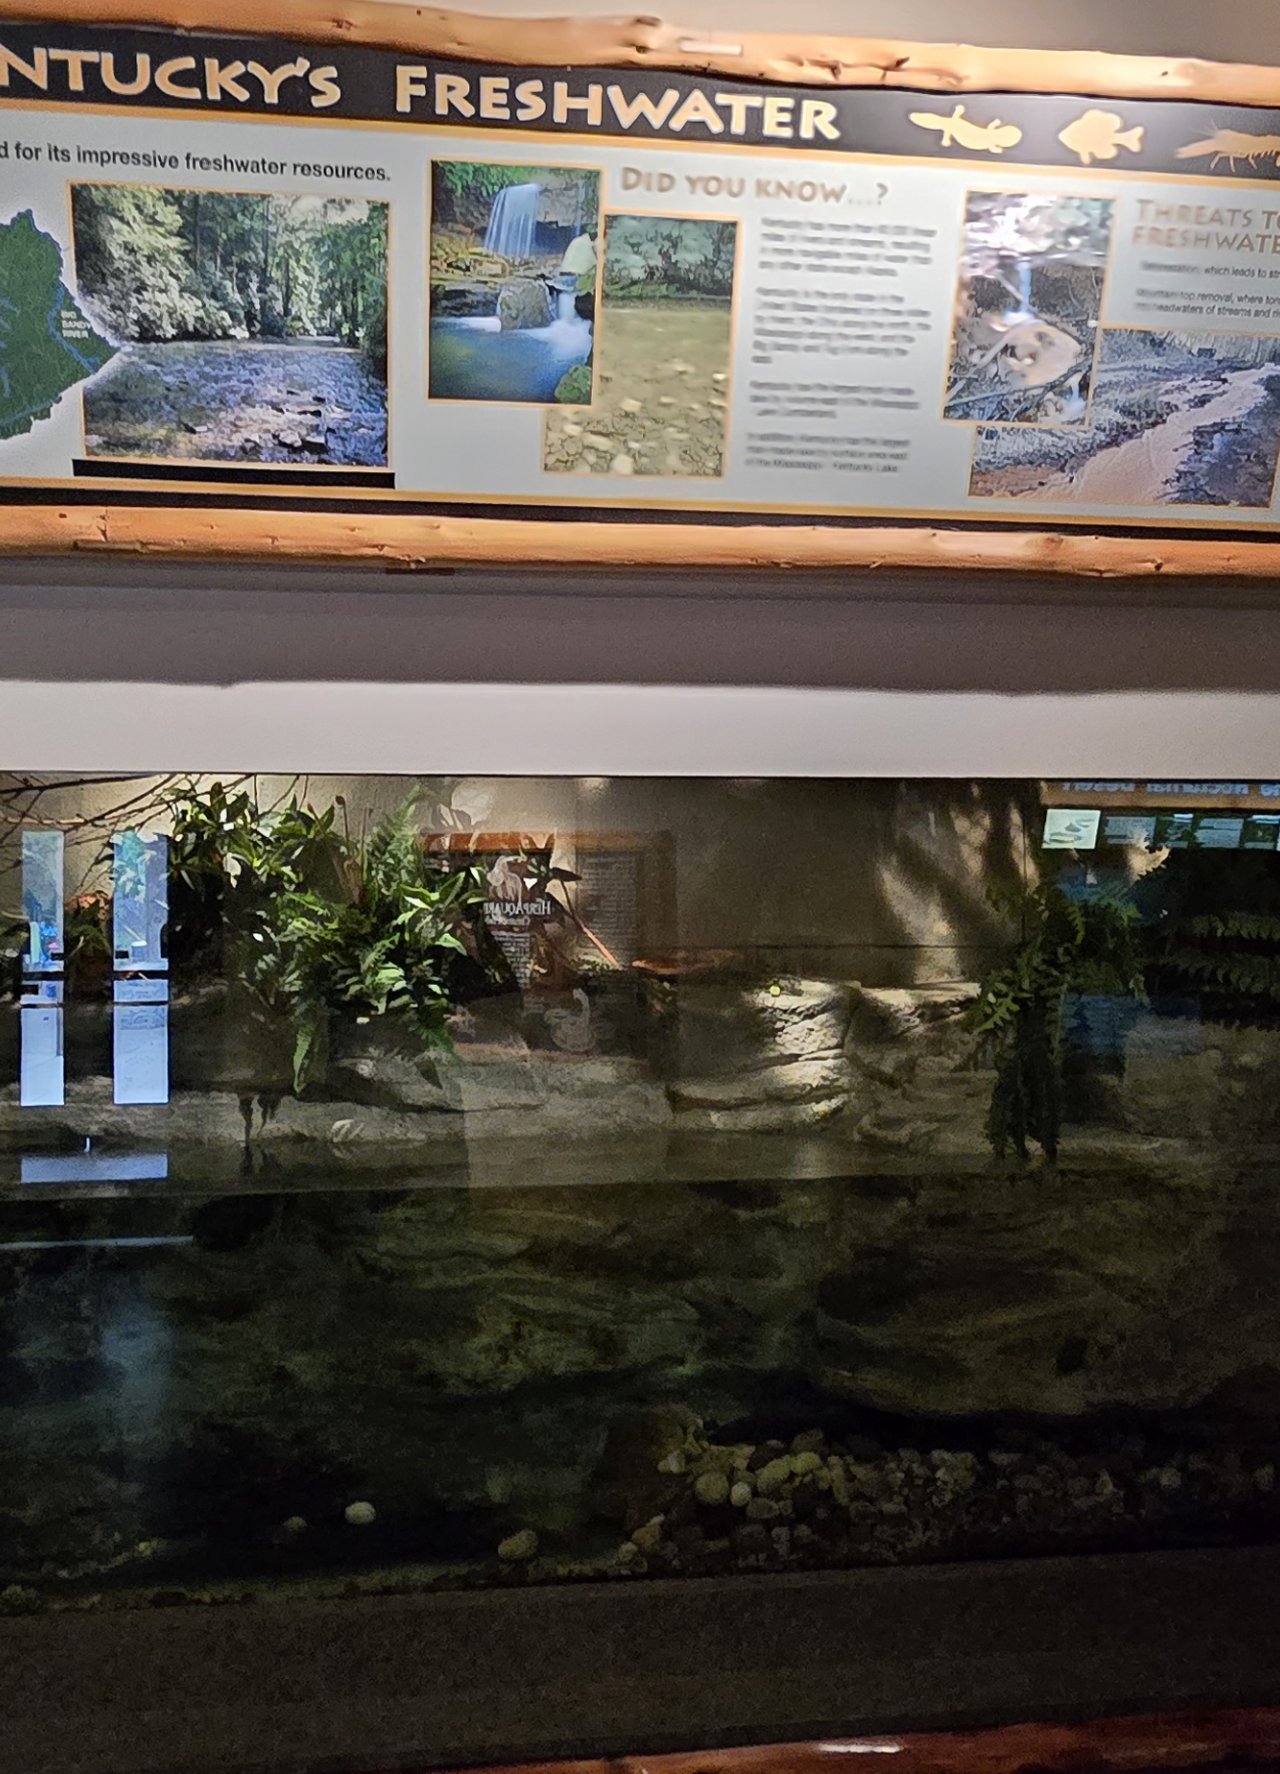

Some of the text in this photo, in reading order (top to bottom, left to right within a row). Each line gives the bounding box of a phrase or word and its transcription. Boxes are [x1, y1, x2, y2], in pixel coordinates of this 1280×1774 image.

[394, 64, 842, 142] FRESHWATER
[14, 141, 43, 161] for
[47, 142, 71, 163] its
[76, 147, 179, 171] impressive
[185, 151, 287, 176] freshwater
[292, 160, 391, 182] resources.
[620, 166, 675, 193] DID
[684, 174, 746, 198] YOU
[1136, 198, 1254, 228] THREATS
[1204, 265, 1230, 277] which
[1232, 266, 1255, 278] leads
[1257, 268, 1267, 278] to
[1205, 304, 1216, 315] of
[1254, 307, 1274, 319] and
